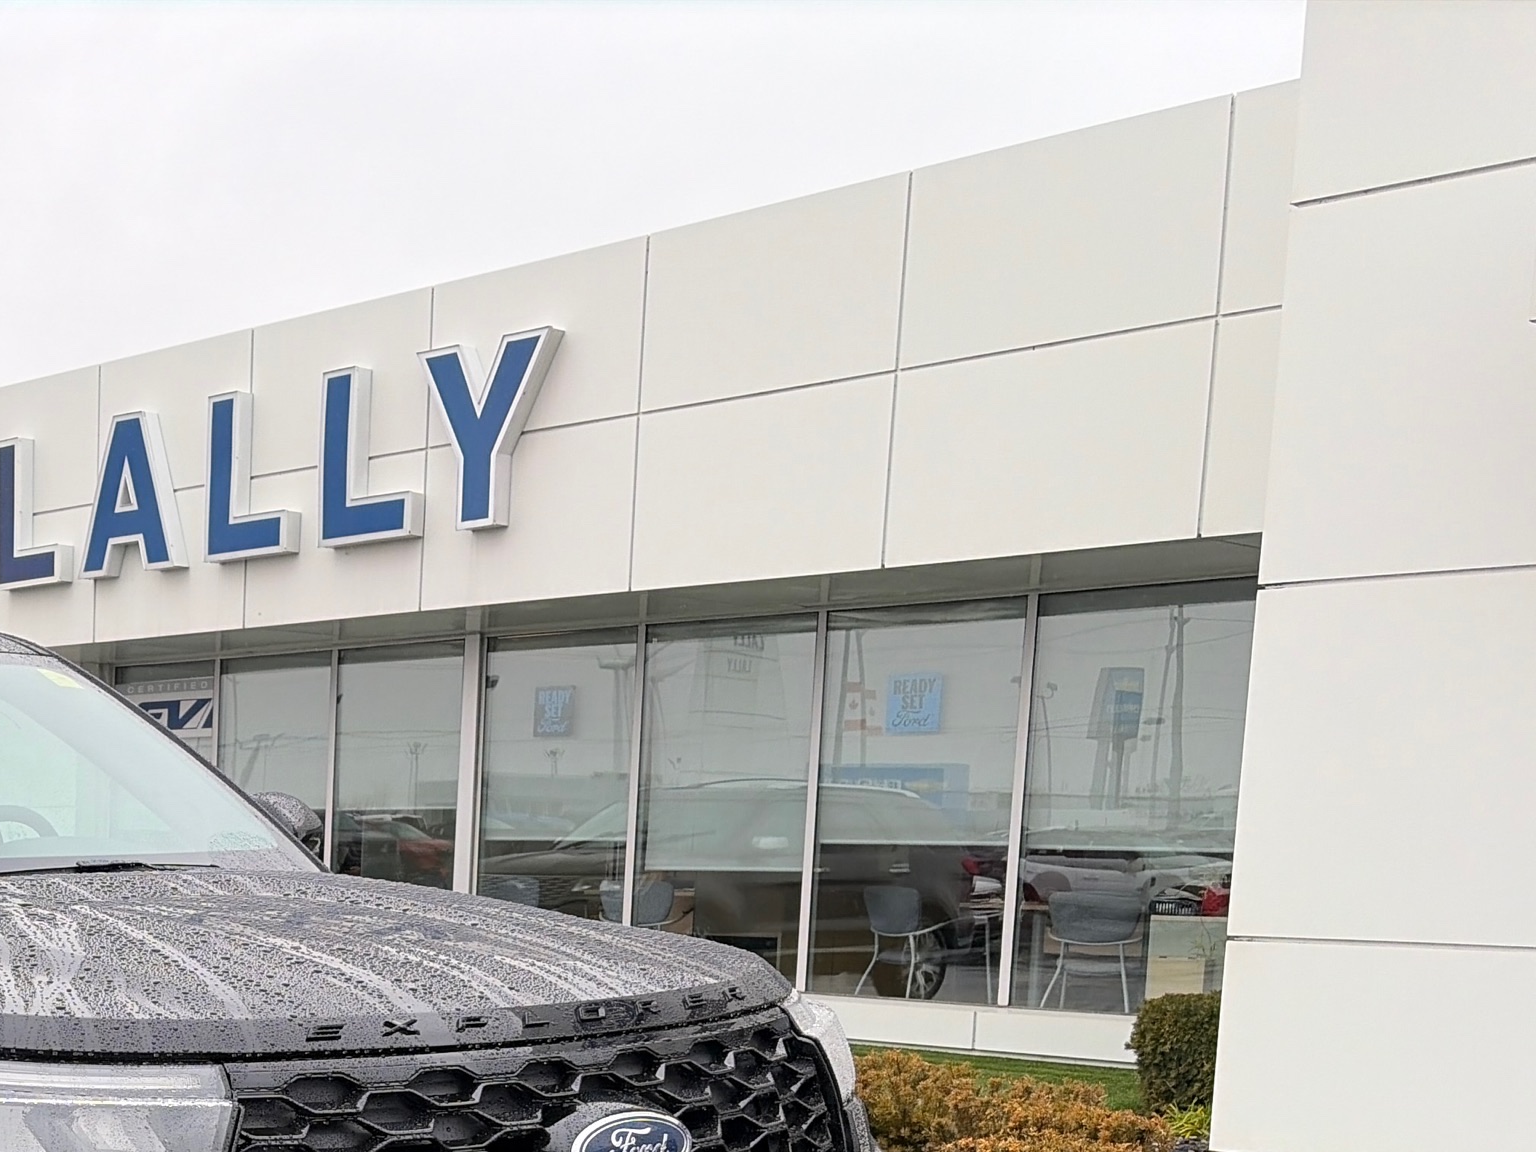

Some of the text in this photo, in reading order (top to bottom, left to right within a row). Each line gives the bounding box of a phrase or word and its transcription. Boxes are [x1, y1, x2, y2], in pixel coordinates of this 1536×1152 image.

[127, 681, 209, 694] CERTIFIED
[894, 677, 937, 695] READY
[538, 689, 572, 705] READY
[901, 694, 925, 710] SET
[544, 703, 563, 717] SET
[891, 710, 930, 728] Ford
[306, 987, 745, 1041] EXPLORER
